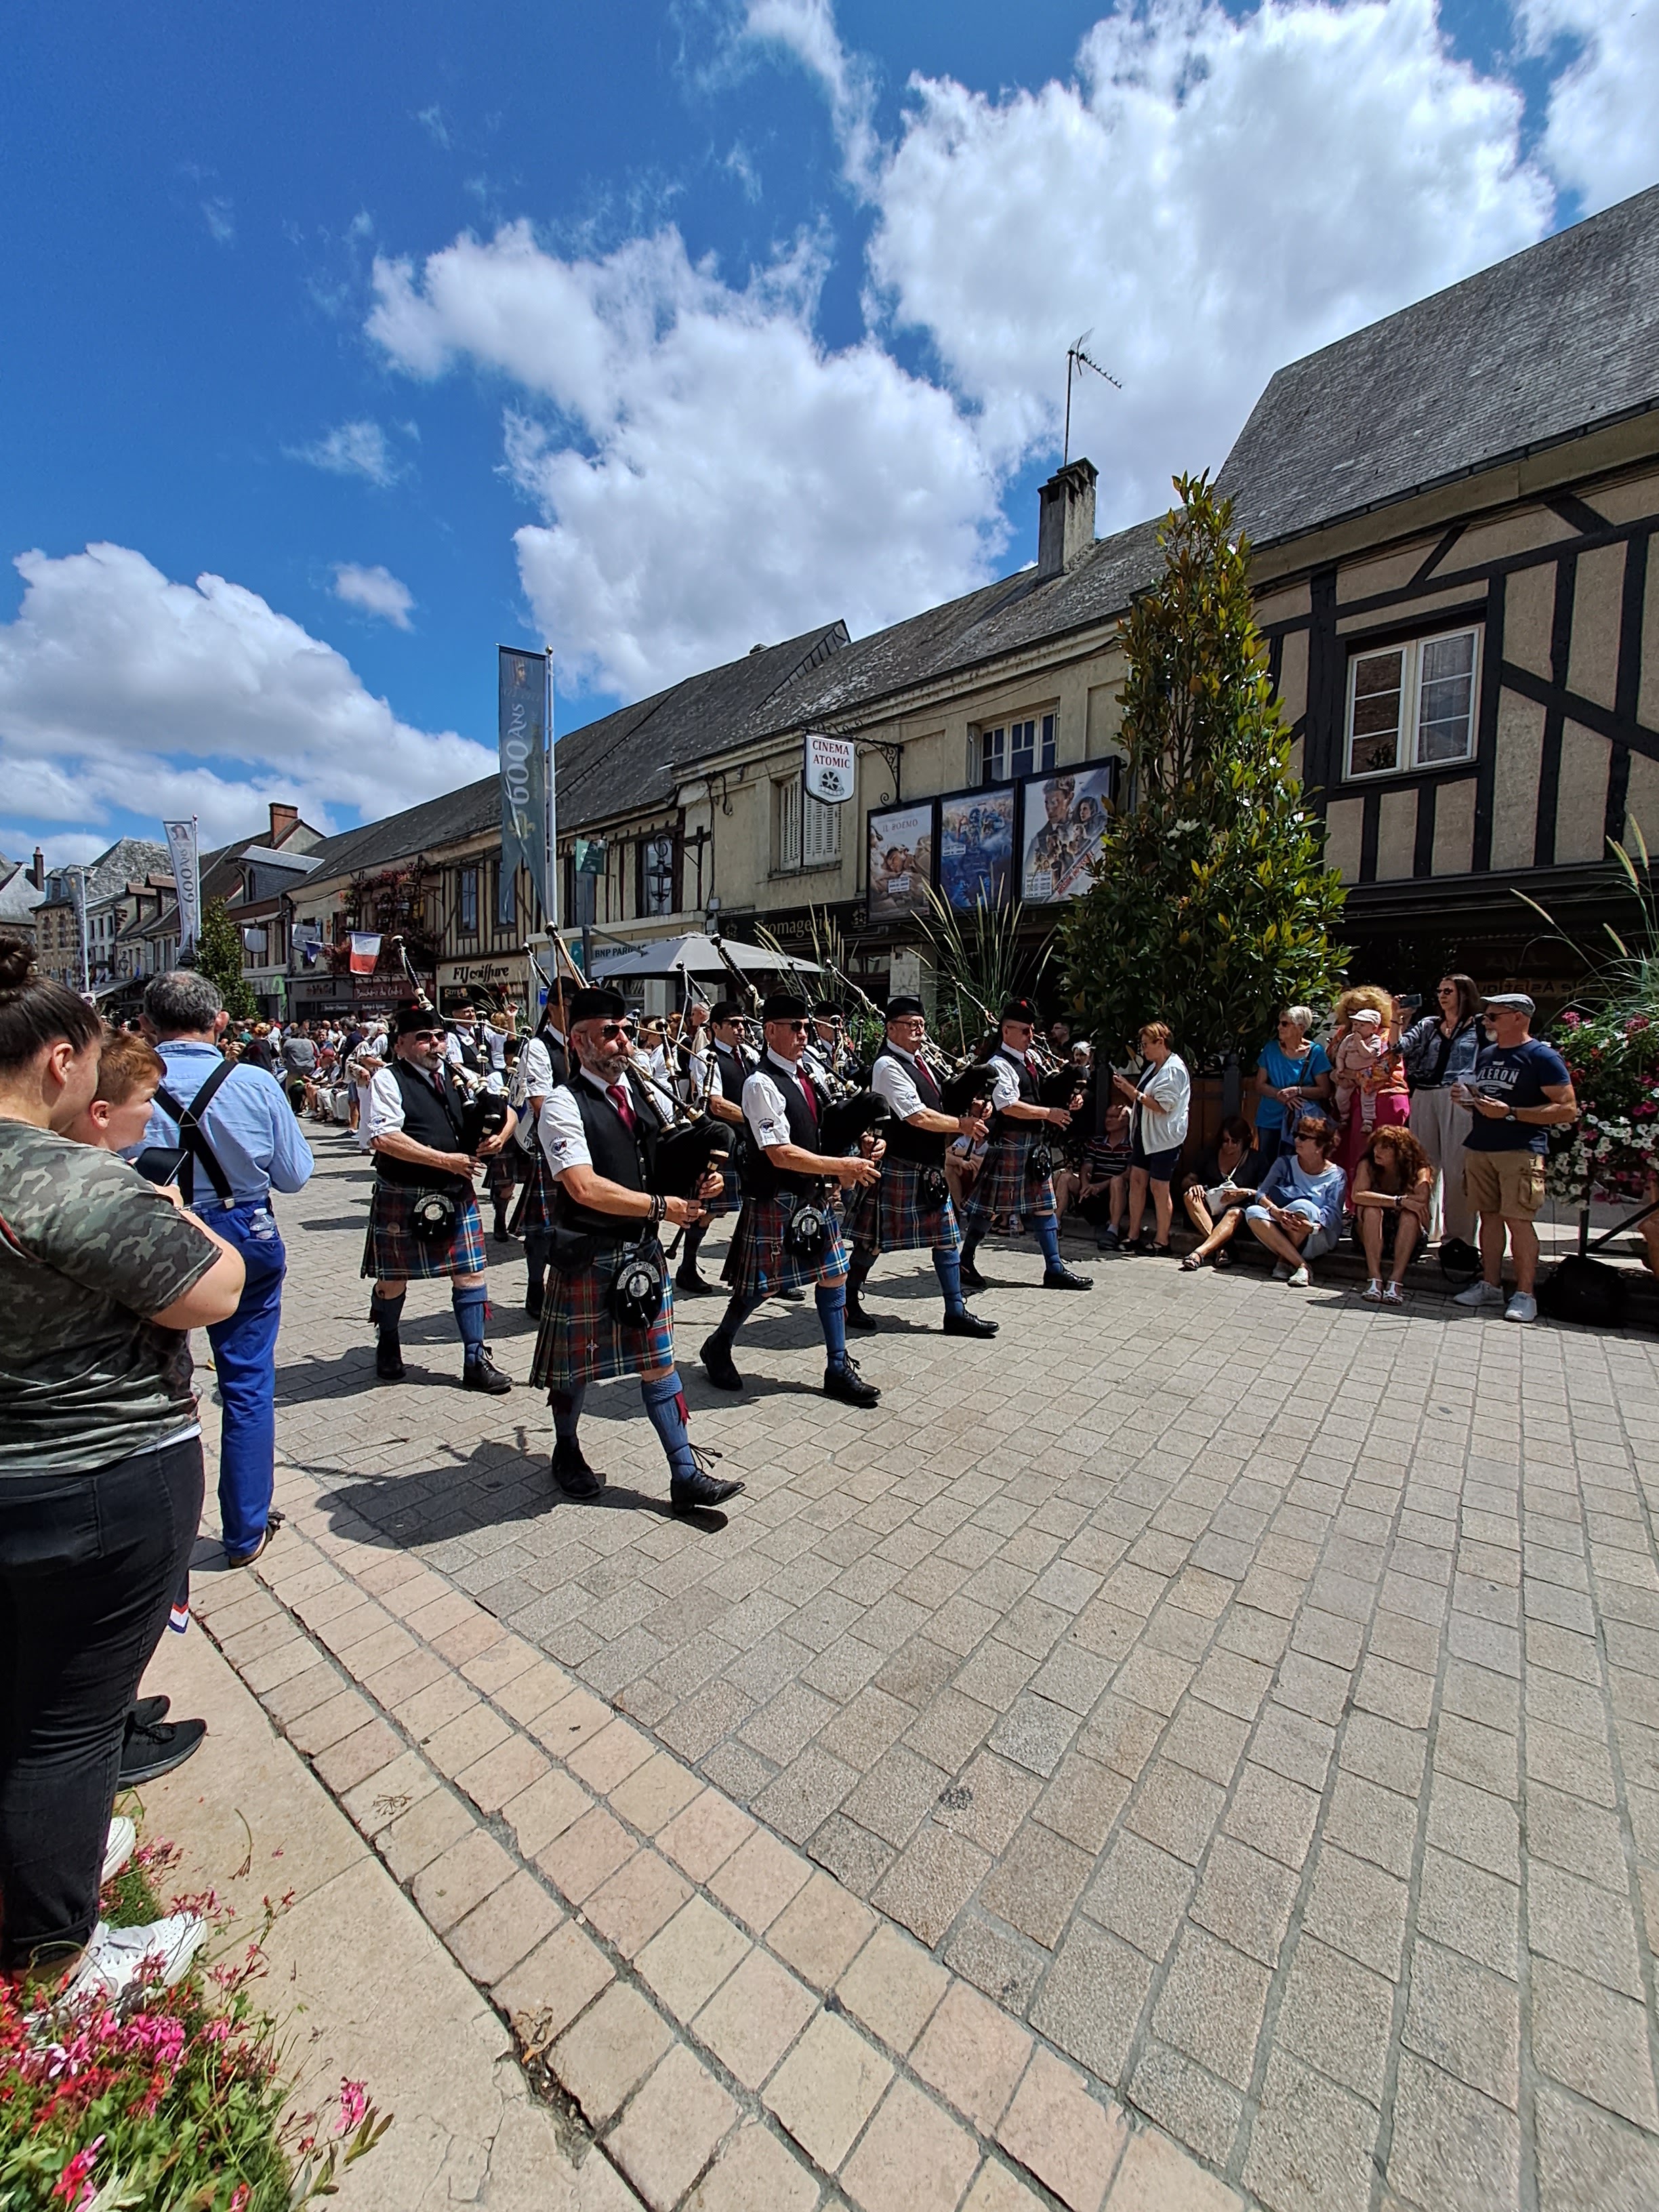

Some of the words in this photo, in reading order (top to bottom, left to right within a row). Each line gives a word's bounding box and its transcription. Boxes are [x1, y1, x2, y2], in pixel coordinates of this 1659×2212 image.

[508, 703, 527, 739] ANS
[813, 740, 850, 755] CINEMA
[813, 754, 850, 769] ATOMIC
[506, 740, 529, 805] 600
[891, 819, 918, 831] BOEMO
[756, 913, 831, 938] Fromagerie
[595, 949, 611, 958] BNP
[613, 944, 647, 957] PARI
